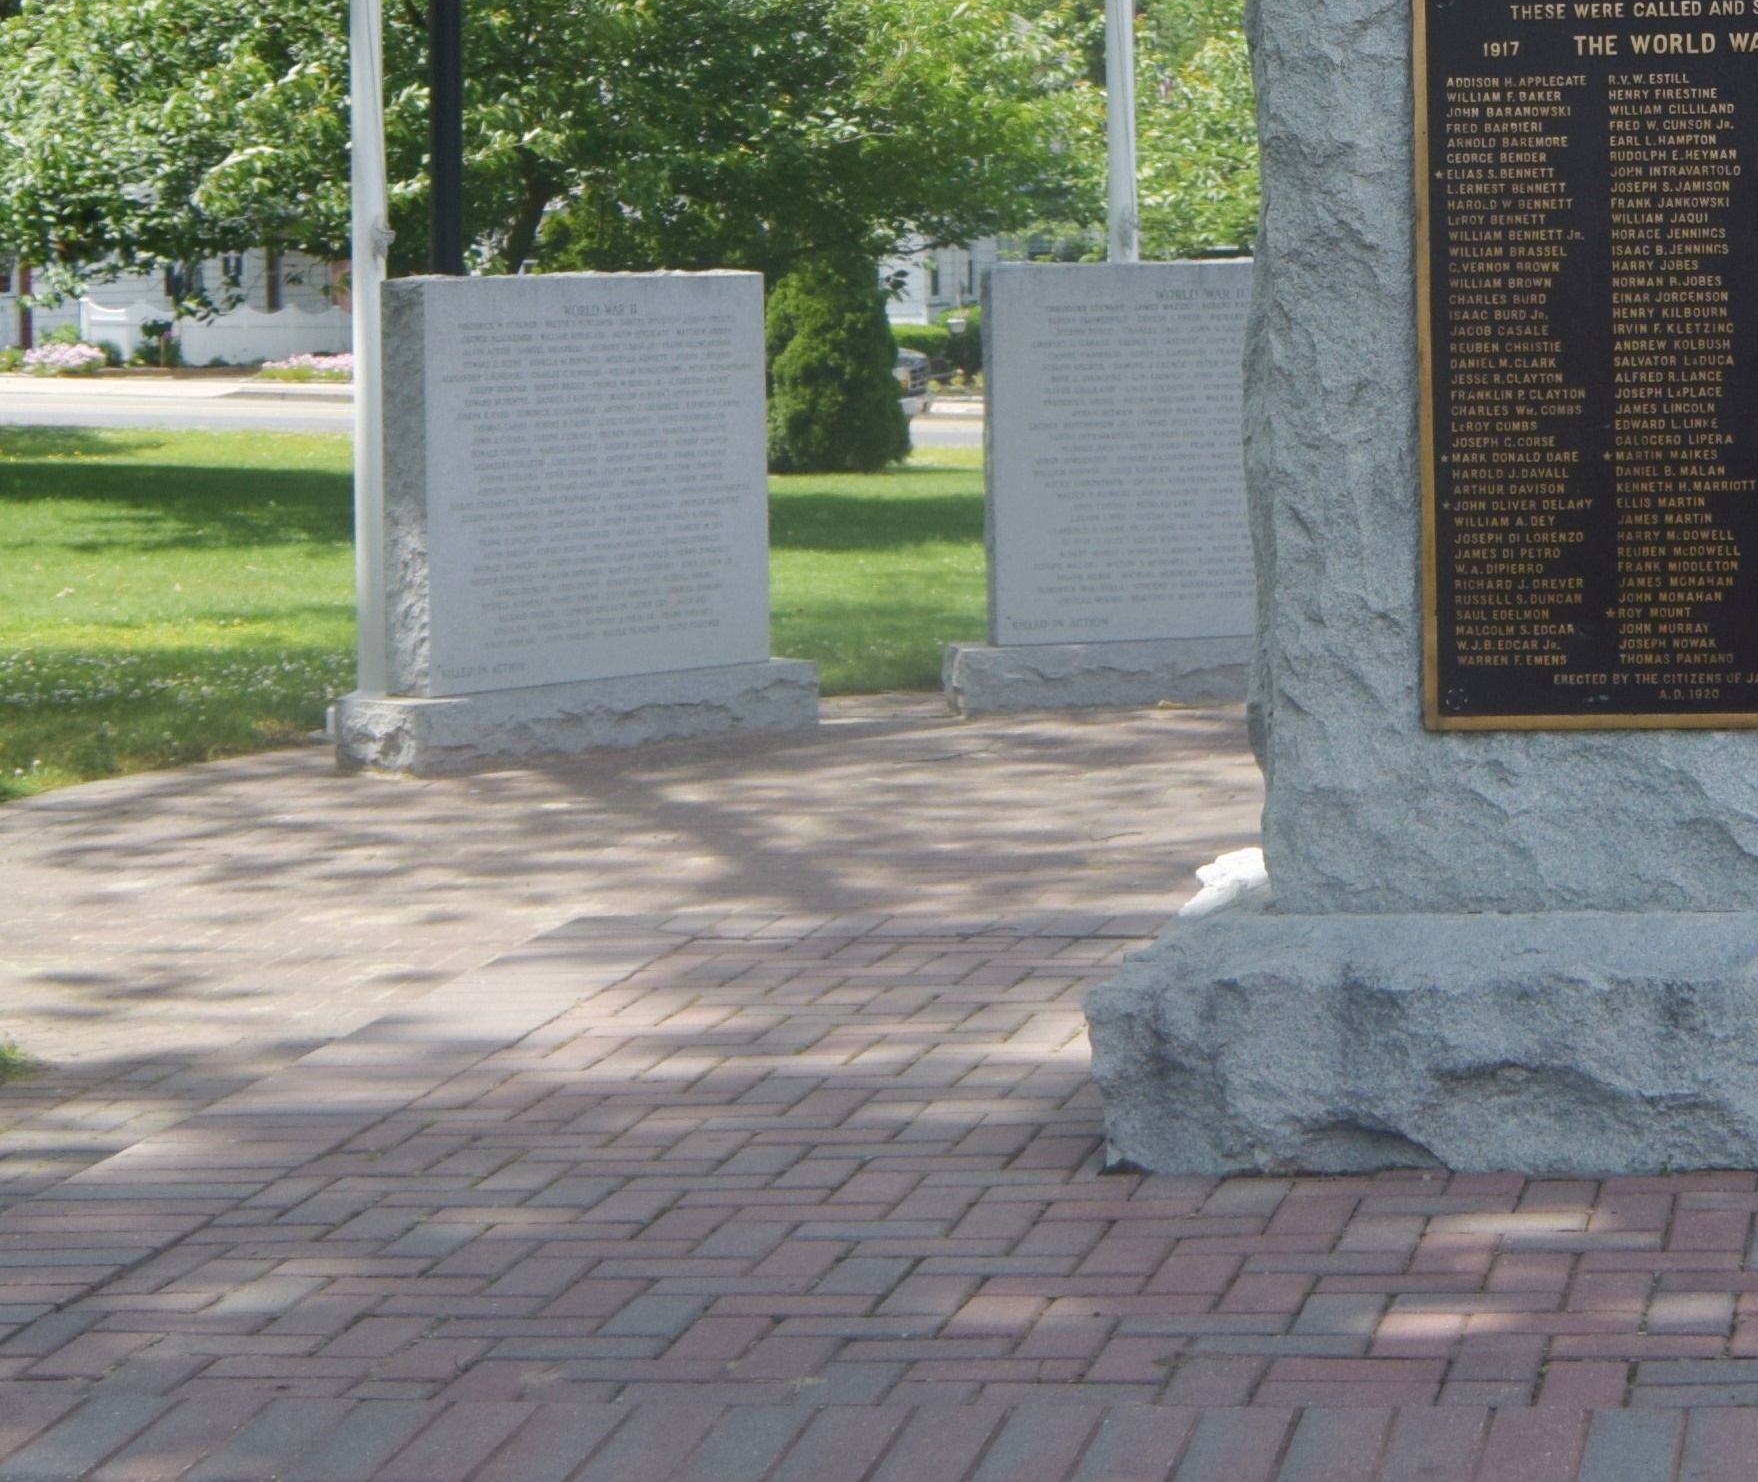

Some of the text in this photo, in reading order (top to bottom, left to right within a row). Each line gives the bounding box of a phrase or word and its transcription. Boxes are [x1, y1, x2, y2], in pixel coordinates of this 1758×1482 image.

[1510, 4, 1566, 20] THESE
[1574, 3, 1624, 19] WERE
[1633, 1, 1702, 18] CALLED
[1709, 0, 1745, 16] AND
[1482, 42, 1520, 57] 1917
[1573, 34, 1617, 56] THE
[1630, 32, 1716, 55] WORLD
[1447, 91, 1501, 103] WILLIAM
[1519, 90, 1561, 102] BAKER
[1609, 87, 1717, 100] HENRY FIRESTINE
[1446, 105, 1571, 118] JOHN BARANOWSKI
[1446, 121, 1477, 133] FRED
[1448, 135, 1567, 148] ARNOLD BAREMORE
[1609, 164, 1741, 177] JOHN INTRAVARTOLO
[1611, 196, 1729, 209] FRANK JANKOWSKI
[1612, 212, 1708, 225] WILLIAM JAQUI
[1449, 245, 1565, 258] WILLIAM BRASSEL
[1612, 259, 1698, 272] HARRY JOBES
[1450, 276, 1552, 289] WILLIAM BROWN
[1153, 289, 1198, 301] WORLD
[1204, 288, 1230, 300] WAR
[1449, 293, 1546, 306] CHARLES BURD
[564, 304, 600, 316] WORLD
[605, 303, 625, 315] WAR
[1613, 306, 1727, 319] HENRY KILBOURN
[1451, 325, 1548, 338] JACOB CASALE
[1450, 340, 1561, 353] REUBEN CHRISTIE
[1614, 339, 1666, 351] ANDREW
[1616, 402, 1715, 415] JAMES LINCOLN
[1452, 450, 1579, 464] MARK DONALD DARE
[1615, 448, 1717, 461] MARTIN MAIKES
[1454, 482, 1565, 495] ARTHUR DAVISON
[1454, 499, 1486, 511] JOHN
[1492, 498, 1536, 510] OLIVER
[1617, 496, 1705, 509] ELLIS MARTIN
[1618, 512, 1712, 525] JAMES MARTIN
[1455, 532, 1503, 544] JOSEPH
[1526, 530, 1584, 542] LORENZO
[1455, 548, 1497, 560] JAMES
[1520, 547, 1560, 559] PETRO
[1618, 560, 1738, 573] FRANK MIDDLETON
[1620, 575, 1733, 588] JAMES MONAHAN
[1619, 590, 1722, 603] JOHN MONAHAN
[1456, 609, 1487, 621] SAUL
[1618, 605, 1691, 618] ROY MOUNT
[1619, 621, 1708, 634] JOHN MURRAY
[1619, 636, 1716, 649] JOSEPH NOWAK
[1458, 654, 1508, 666] WARREN
[1526, 653, 1567, 665] EMENS
[1620, 653, 1670, 665] THOMAS
[1554, 673, 1607, 685] ERECTED
[1613, 673, 1629, 685] BY
[1635, 673, 1658, 685] THE
[1663, 672, 1721, 684] CITIZENS
[1727, 672, 1742, 684] OF
[1690, 688, 1720, 700] 1920
